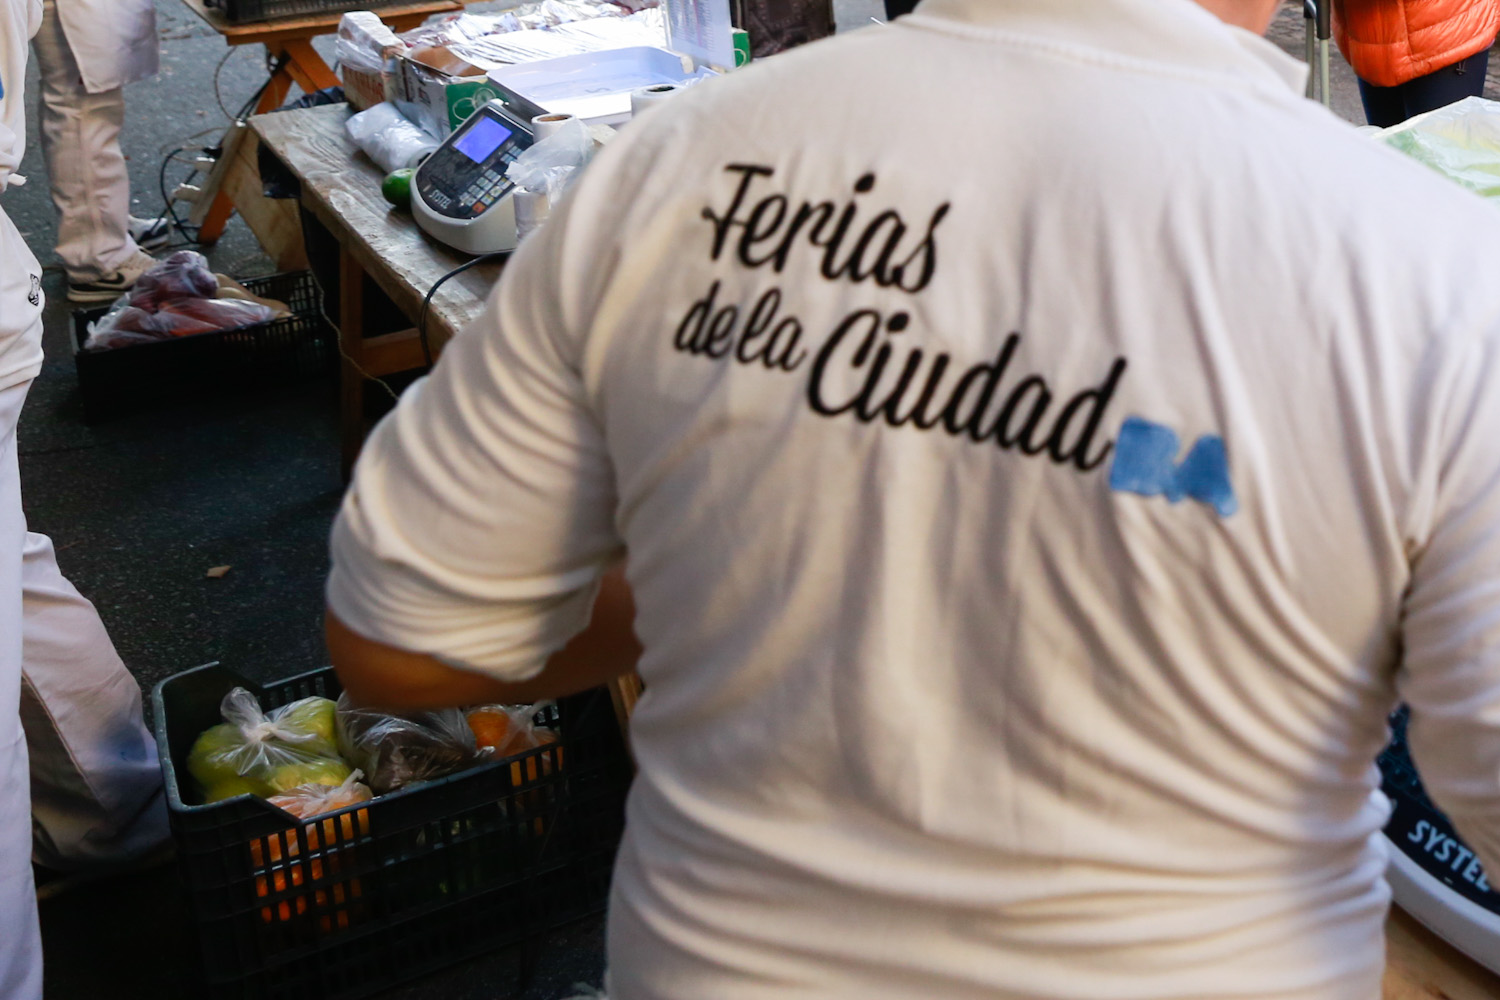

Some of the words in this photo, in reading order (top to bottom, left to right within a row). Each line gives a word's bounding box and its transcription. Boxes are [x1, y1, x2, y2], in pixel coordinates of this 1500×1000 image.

[701, 163, 951, 294] Ferias
[805, 309, 1128, 473] Ciudad
[1406, 819, 1491, 893] SYSTEL
